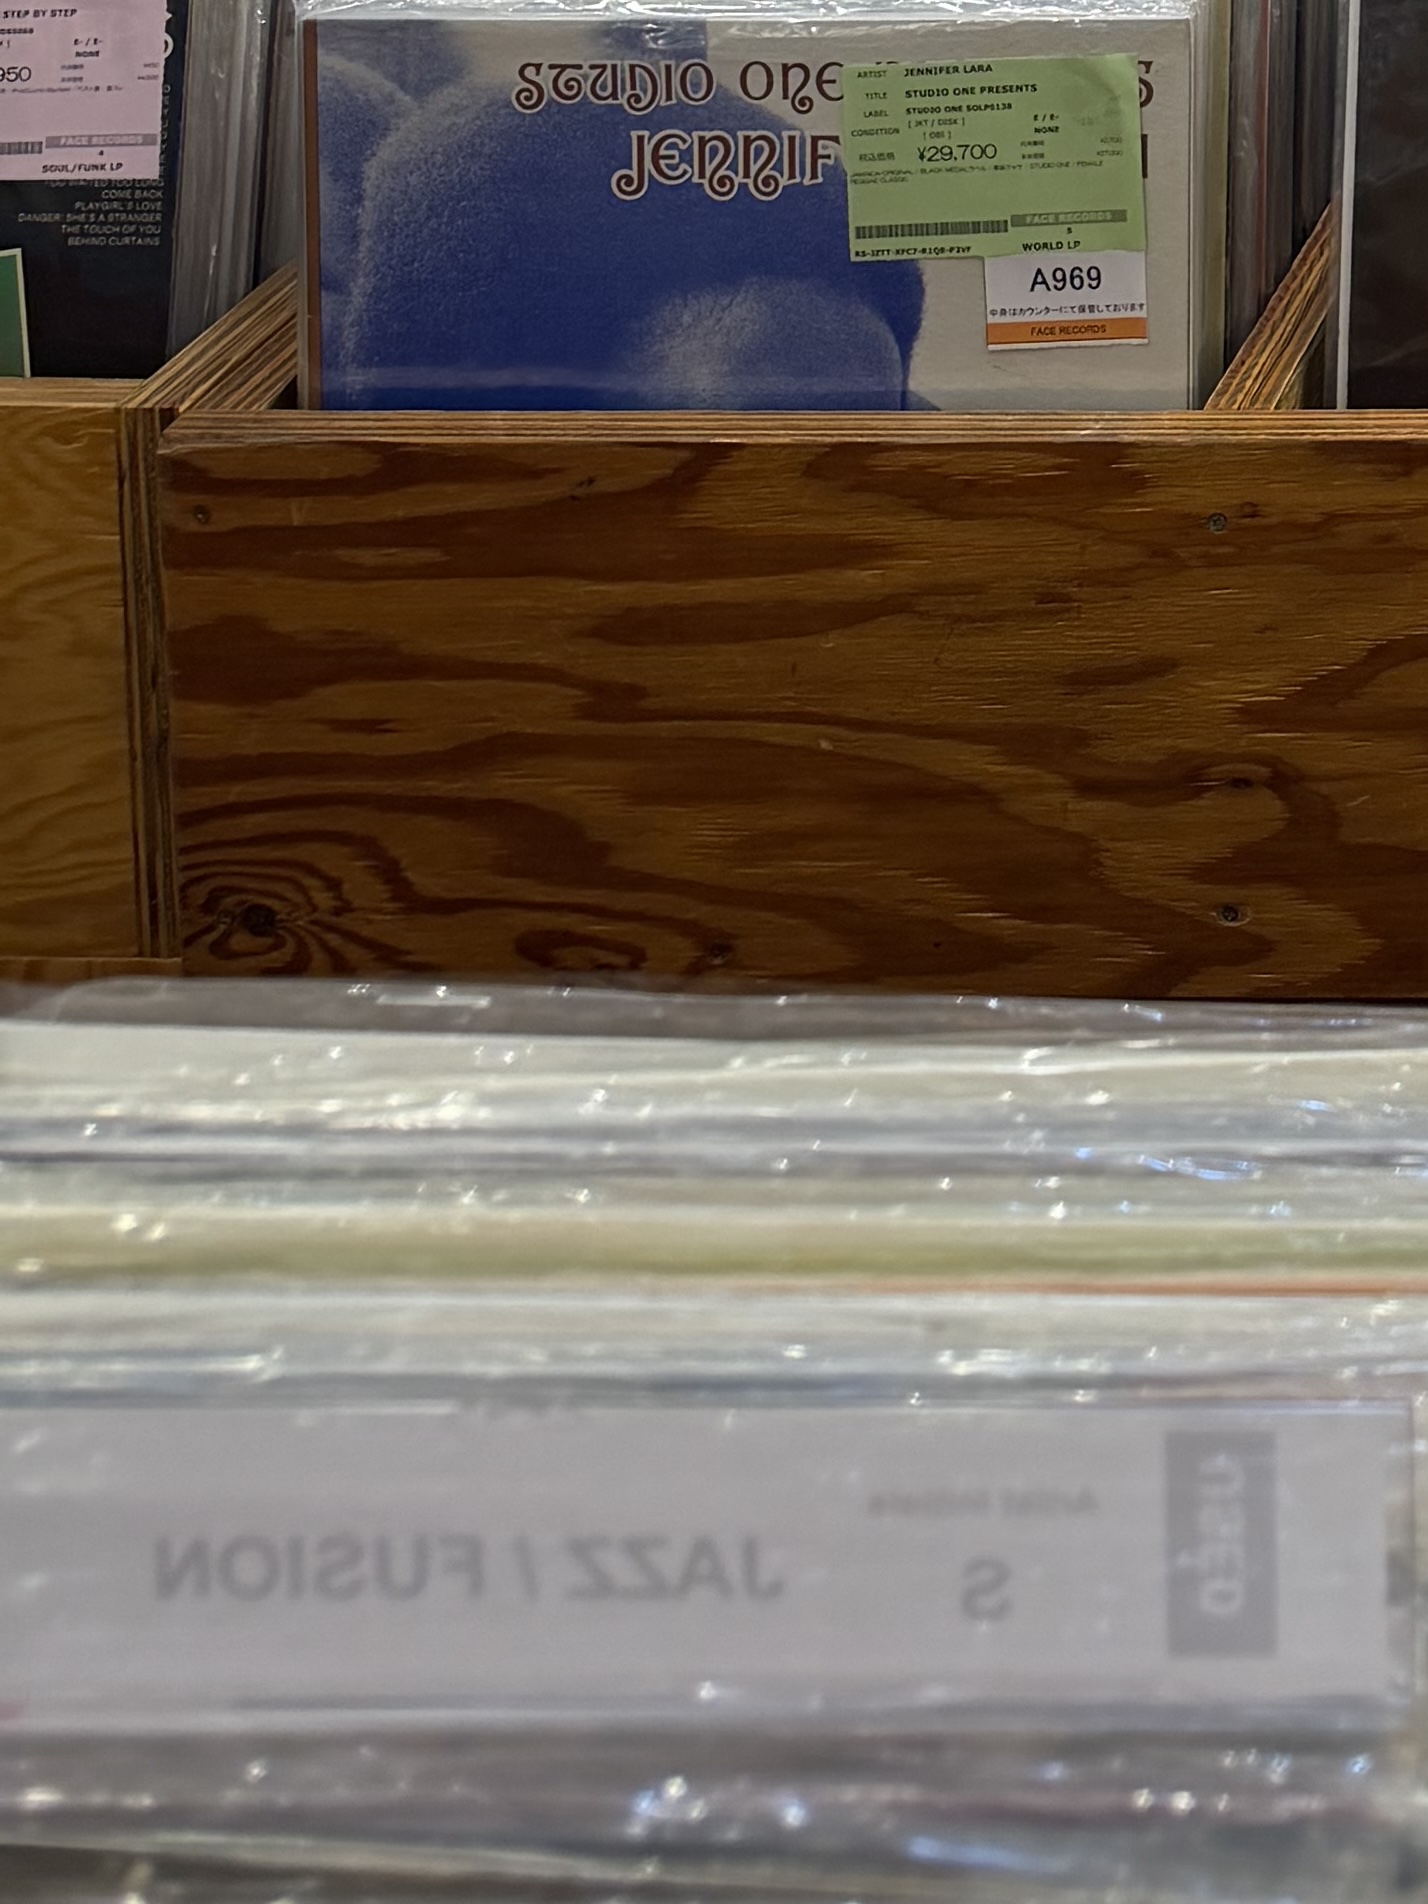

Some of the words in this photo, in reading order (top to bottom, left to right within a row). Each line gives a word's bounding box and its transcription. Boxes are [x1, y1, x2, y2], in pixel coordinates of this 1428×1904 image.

[904, 65, 960, 77] JENNIFER
[963, 64, 993, 74] LARA
[513, 59, 714, 115] STUDIO
[738, 59, 842, 115] ONE
[905, 87, 950, 99] STUDIO
[952, 86, 976, 97] ONE
[979, 83, 1038, 95] PRESENTS
[906, 106, 941, 115] STUDIO
[944, 105, 963, 114] ONE
[1034, 126, 1060, 134] NONE
[917, 143, 998, 163] ¥29,700
[42, 163, 107, 174] SOUL/FUNK
[611, 129, 841, 201] JENNIF
[134, 190, 163, 199] BACK
[135, 201, 163, 211] LOVE
[138, 224, 161, 234] YOU
[1022, 241, 1064, 252] WORLD
[1067, 240, 1081, 250] LP
[1030, 265, 1102, 292] A969
[1030, 326, 1056, 336] FACE
[1059, 324, 1107, 335] RECORDS
